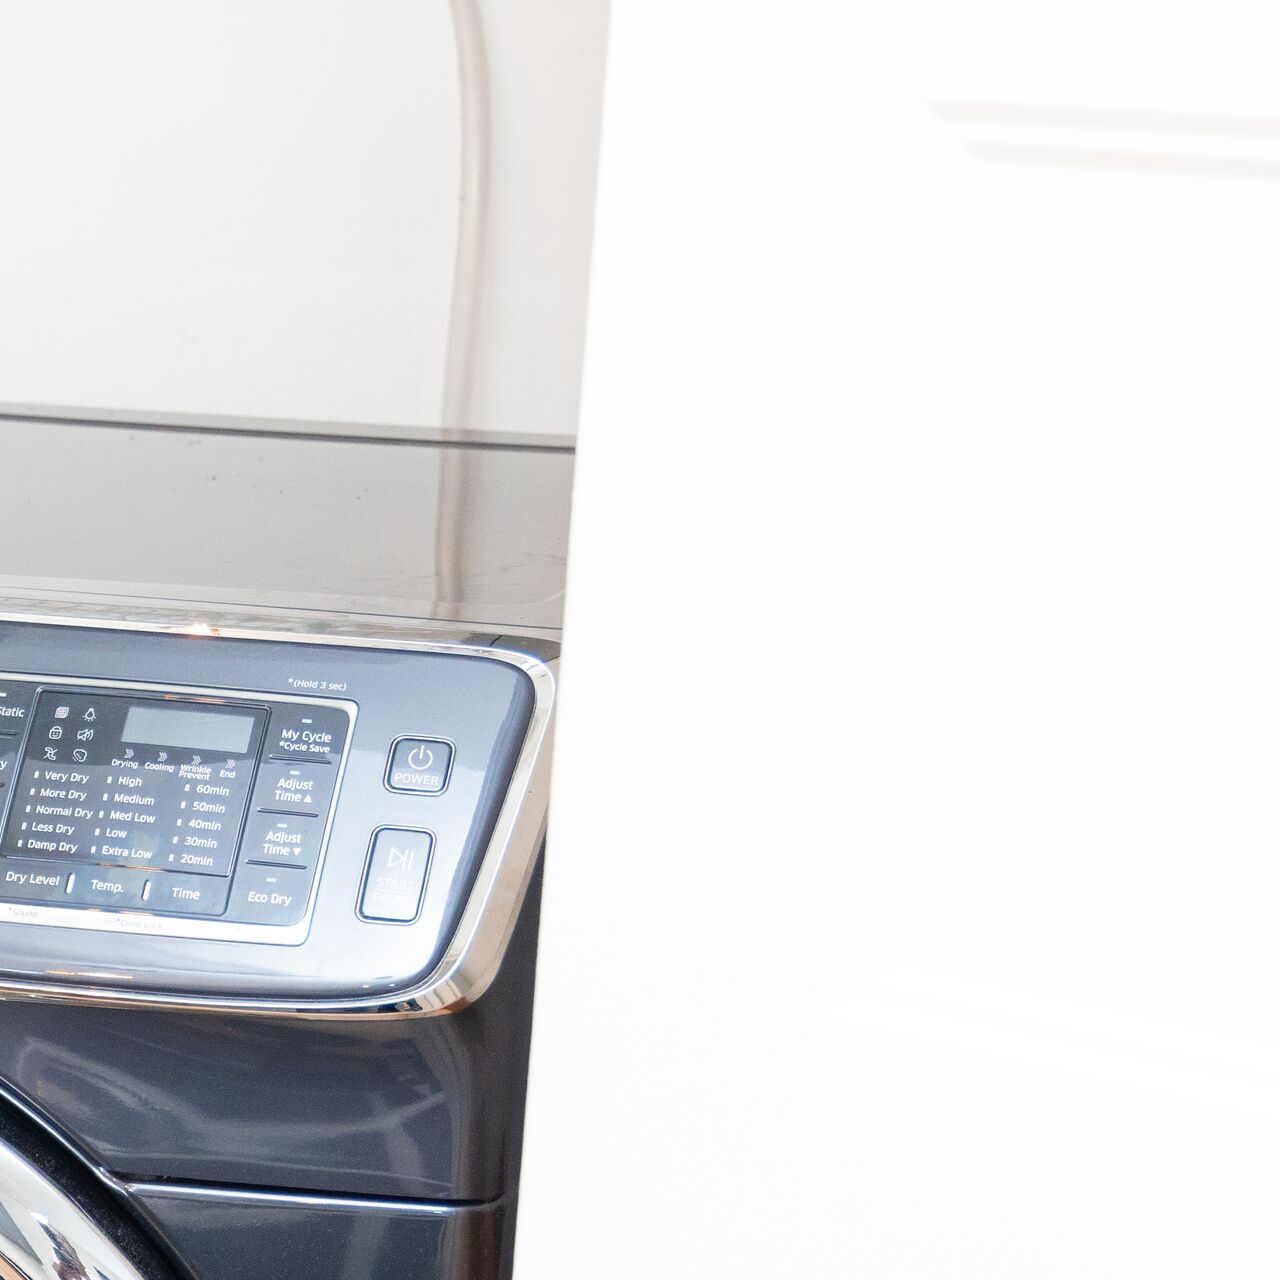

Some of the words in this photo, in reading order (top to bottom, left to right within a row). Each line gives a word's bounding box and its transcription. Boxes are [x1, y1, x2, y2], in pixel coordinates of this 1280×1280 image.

[320, 681, 326, 689] 3
[328, 681, 347, 691] sec)
[281, 729, 300, 741] My
[302, 730, 332, 743] Cycle
[309, 744, 331, 753] Save
[111, 758, 139, 769] Drying
[144, 762, 175, 773] Cooling
[180, 764, 212, 774] Wrinkle
[44, 771, 69, 782] Very
[70, 773, 89, 784] Dry
[179, 771, 211, 781] Prevent
[220, 770, 236, 779] End
[394, 772, 440, 786] POWER
[118, 776, 143, 787] High
[277, 778, 314, 791] Adjust
[40, 789, 66, 799] More
[67, 790, 87, 801] Dry
[196, 784, 230, 796] 60min
[274, 790, 302, 802] Time
[114, 793, 155, 806] Medium
[36, 805, 72, 816] Normal
[74, 808, 93, 819] Dry
[192, 801, 226, 814] 50min
[110, 810, 133, 821] Med
[134, 813, 156, 824] Low
[31, 822, 53, 833] Less
[55, 824, 75, 835] Dry
[188, 818, 222, 831] 40min
[106, 828, 127, 838] Low
[265, 831, 302, 844] Adjust
[27, 840, 56, 851] Damp
[57, 842, 78, 853] Dry
[184, 836, 218, 849] 30min
[101, 846, 129, 857] Extra
[131, 849, 153, 859] Low
[263, 843, 291, 856] Time
[180, 854, 214, 866] 20min
[6, 872, 28, 884] Dry
[29, 874, 60, 886] Level
[91, 880, 124, 893] Temp.
[172, 887, 201, 900] Time
[248, 892, 268, 903] Eco
[270, 894, 292, 907] Dry
